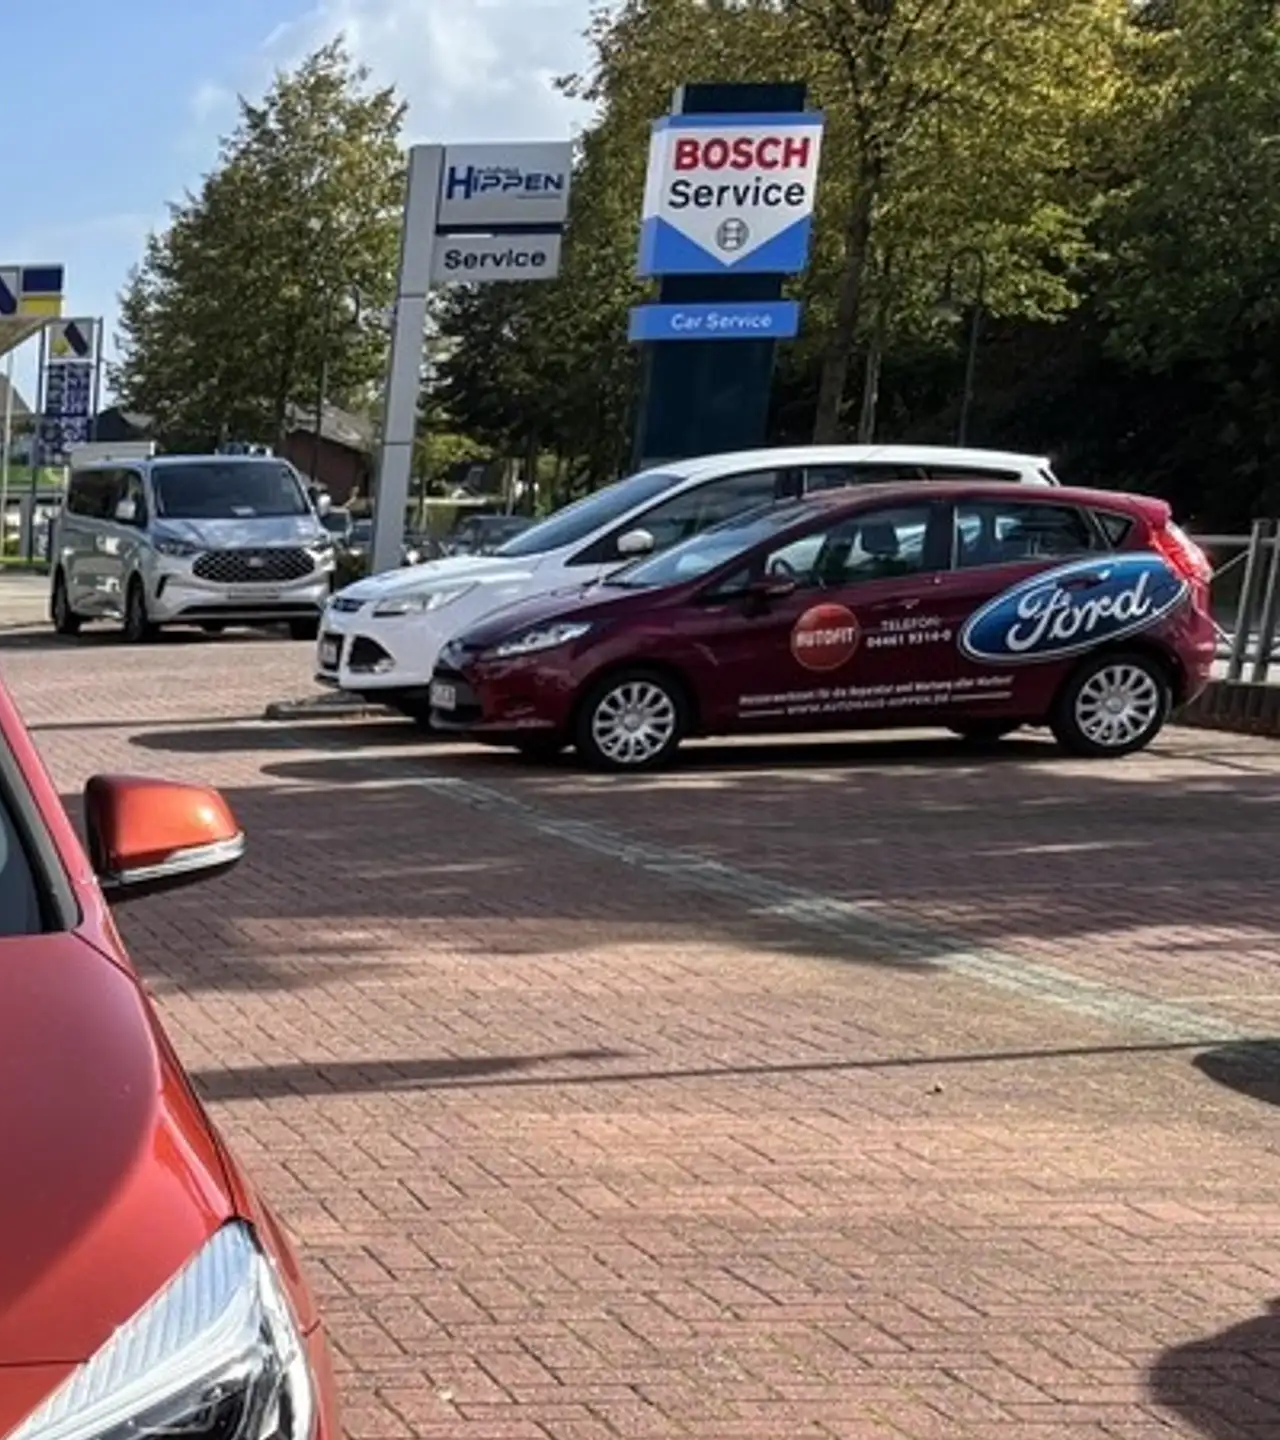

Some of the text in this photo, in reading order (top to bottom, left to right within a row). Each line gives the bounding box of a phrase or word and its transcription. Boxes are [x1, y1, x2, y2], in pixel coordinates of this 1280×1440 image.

[674, 137, 810, 171] BOSCH
[447, 165, 564, 199] HIPPEN
[668, 176, 805, 209] Service
[444, 248, 546, 270] Service
[670, 310, 772, 330] Car Service
[1006, 571, 1152, 651] Ford
